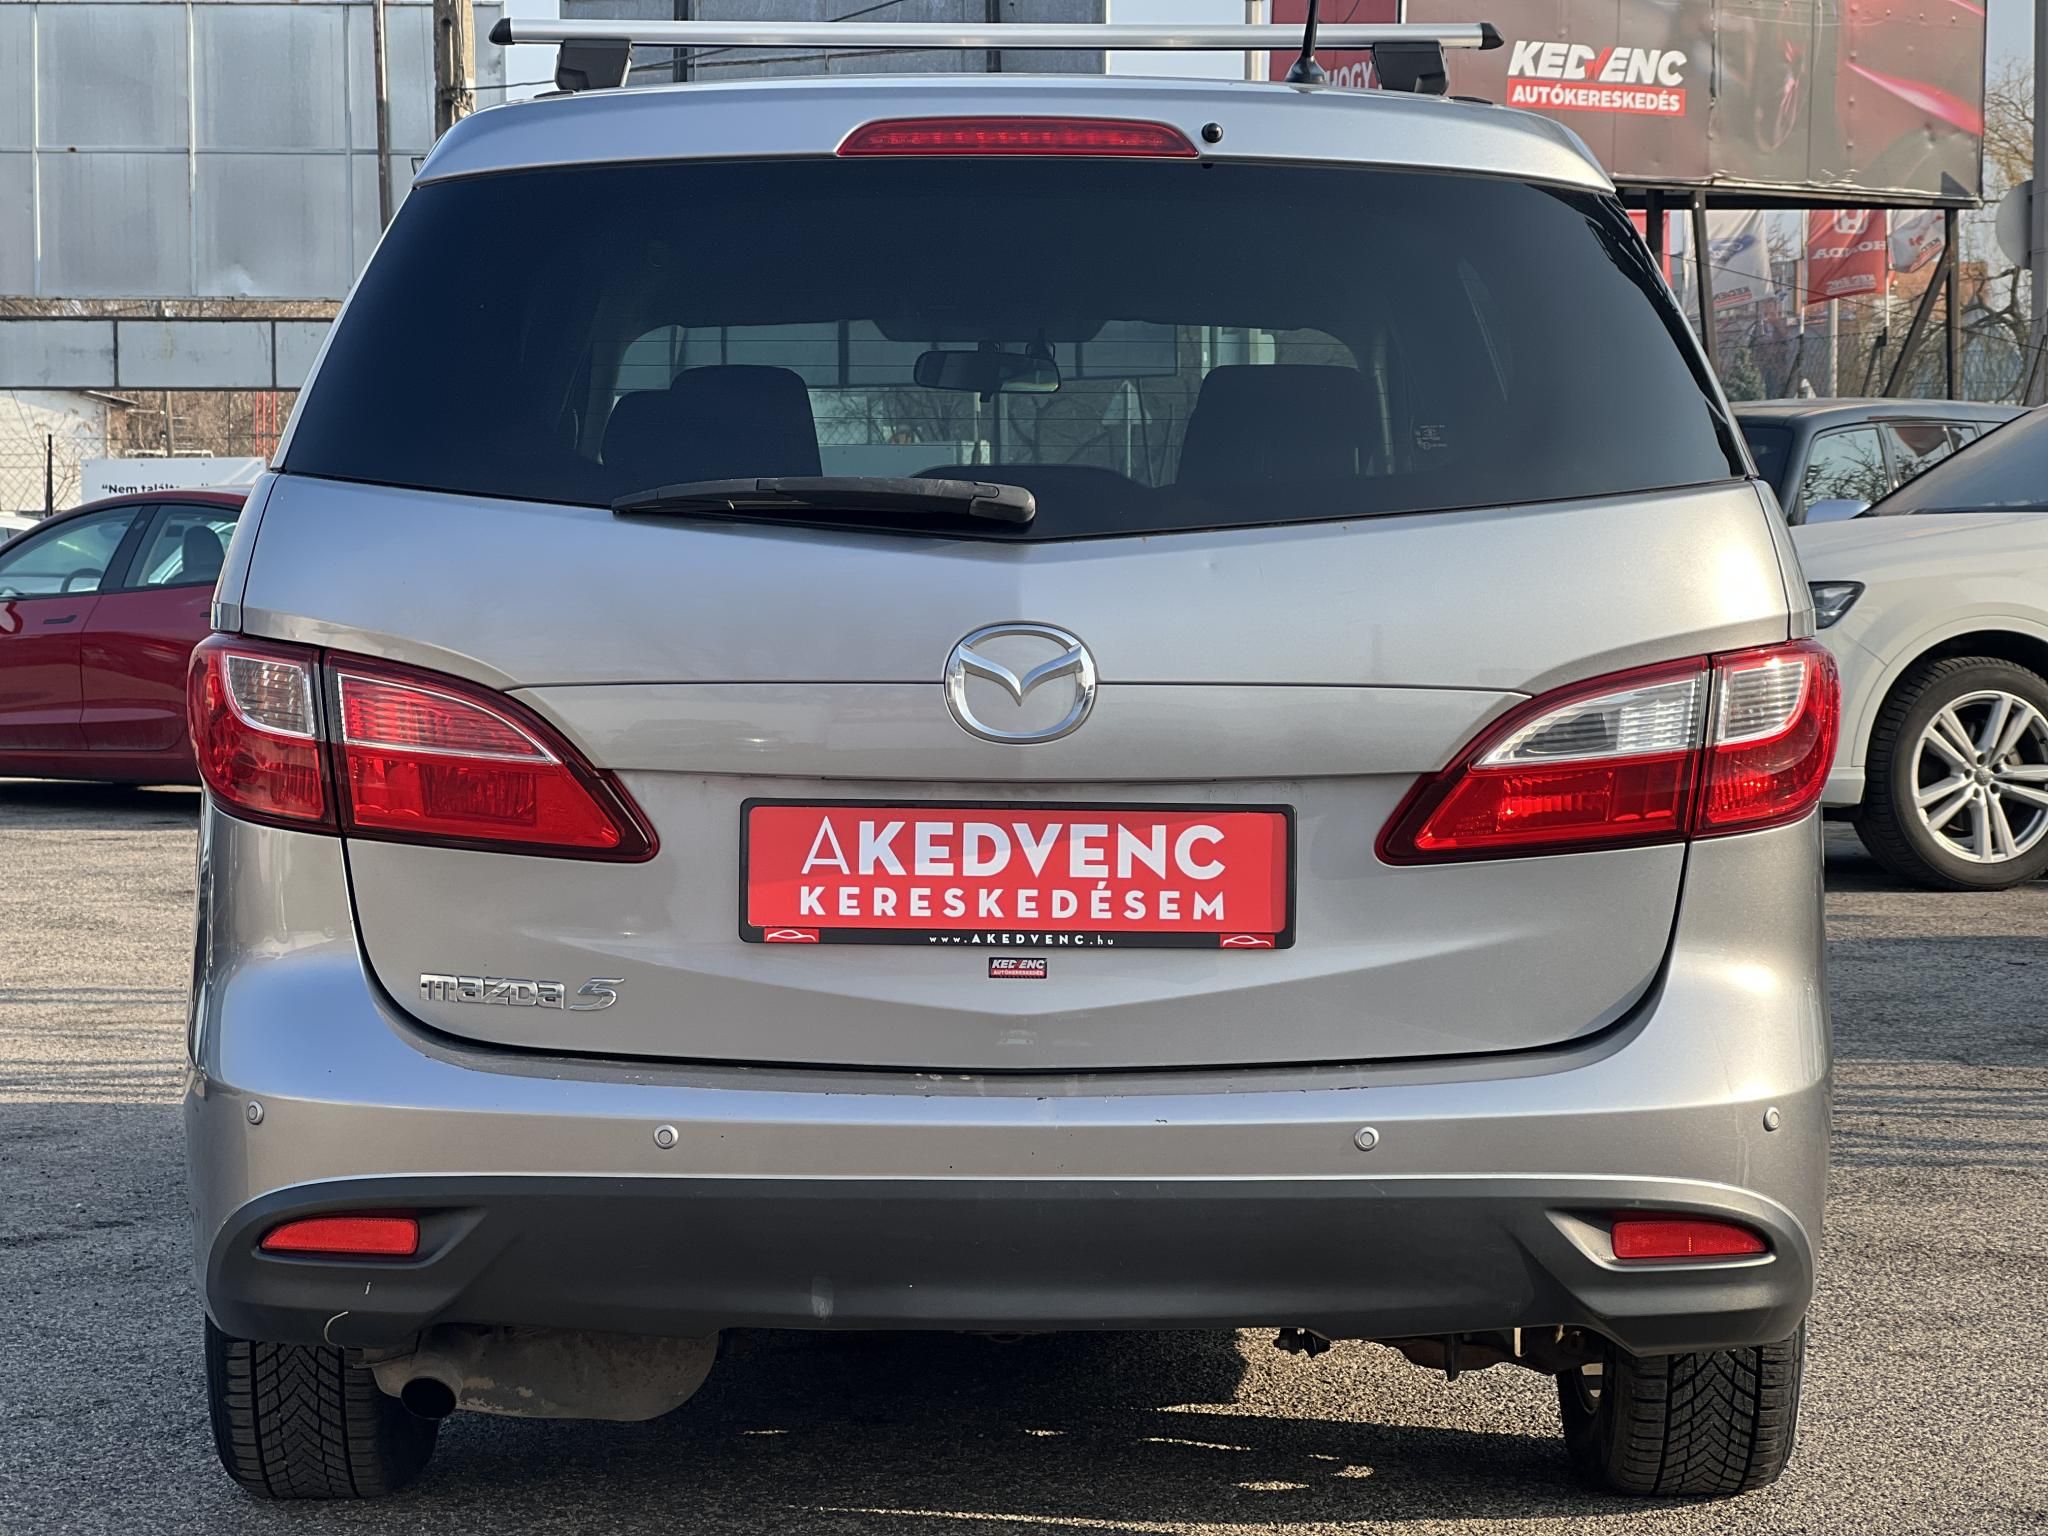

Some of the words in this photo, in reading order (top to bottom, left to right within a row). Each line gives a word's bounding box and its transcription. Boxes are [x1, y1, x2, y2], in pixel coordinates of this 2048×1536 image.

[1507, 39, 1687, 87] KEDVENC
[1512, 83, 1680, 112] AUTÓKERESKEDÉS
[800, 880, 1225, 921] KERESKEDÉSEM
[929, 933, 1114, 947] www.AKEDVENC.hu
[992, 959, 1045, 969] KEDVENC
[569, 978, 625, 1011] 5
